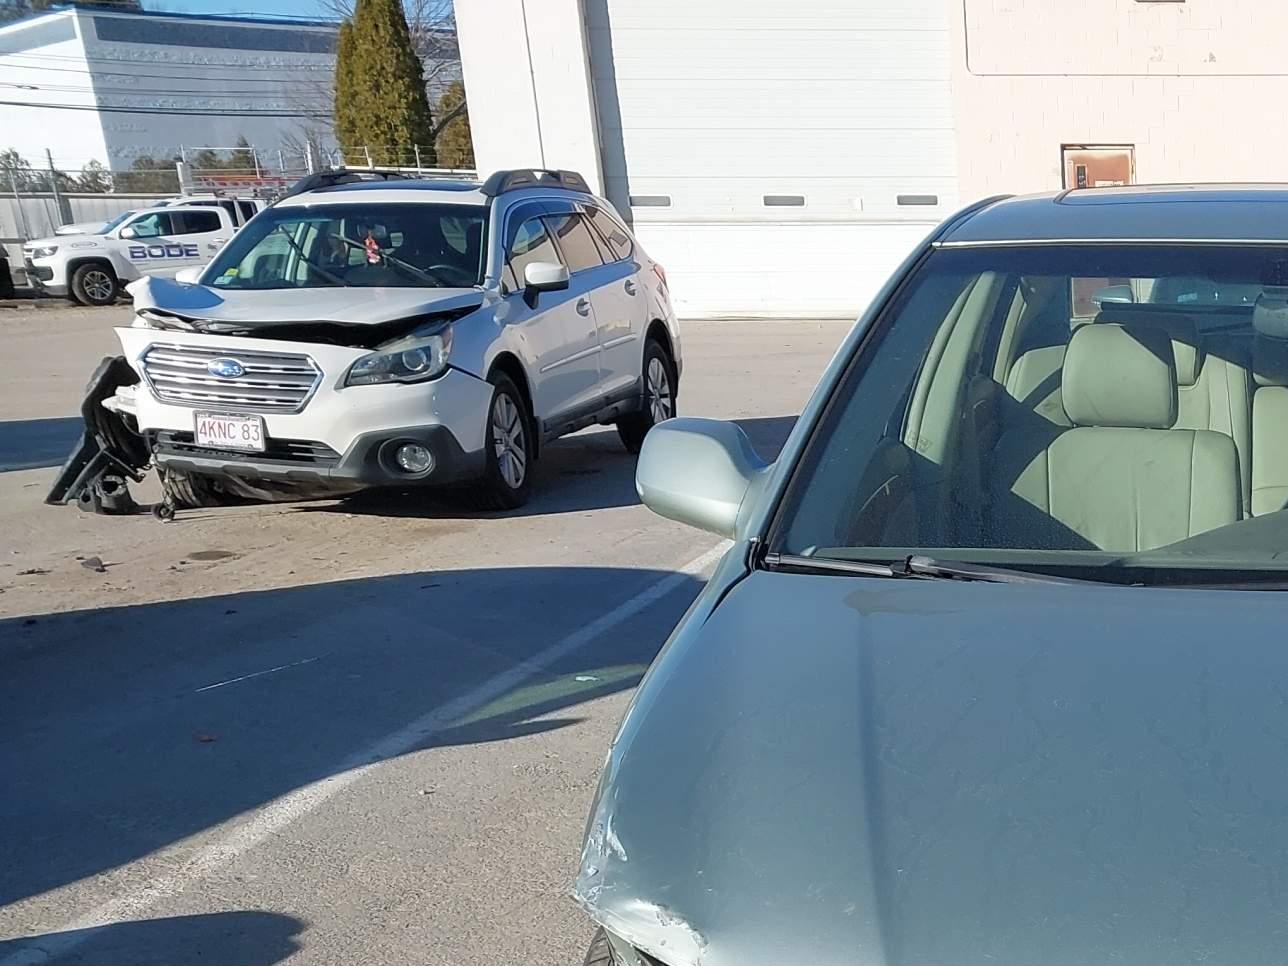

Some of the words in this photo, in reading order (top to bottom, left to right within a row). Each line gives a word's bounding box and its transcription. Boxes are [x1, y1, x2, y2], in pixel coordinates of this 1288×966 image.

[128, 244, 200, 259] BODE
[199, 420, 237, 440] 4KNC
[241, 423, 260, 442] 83
